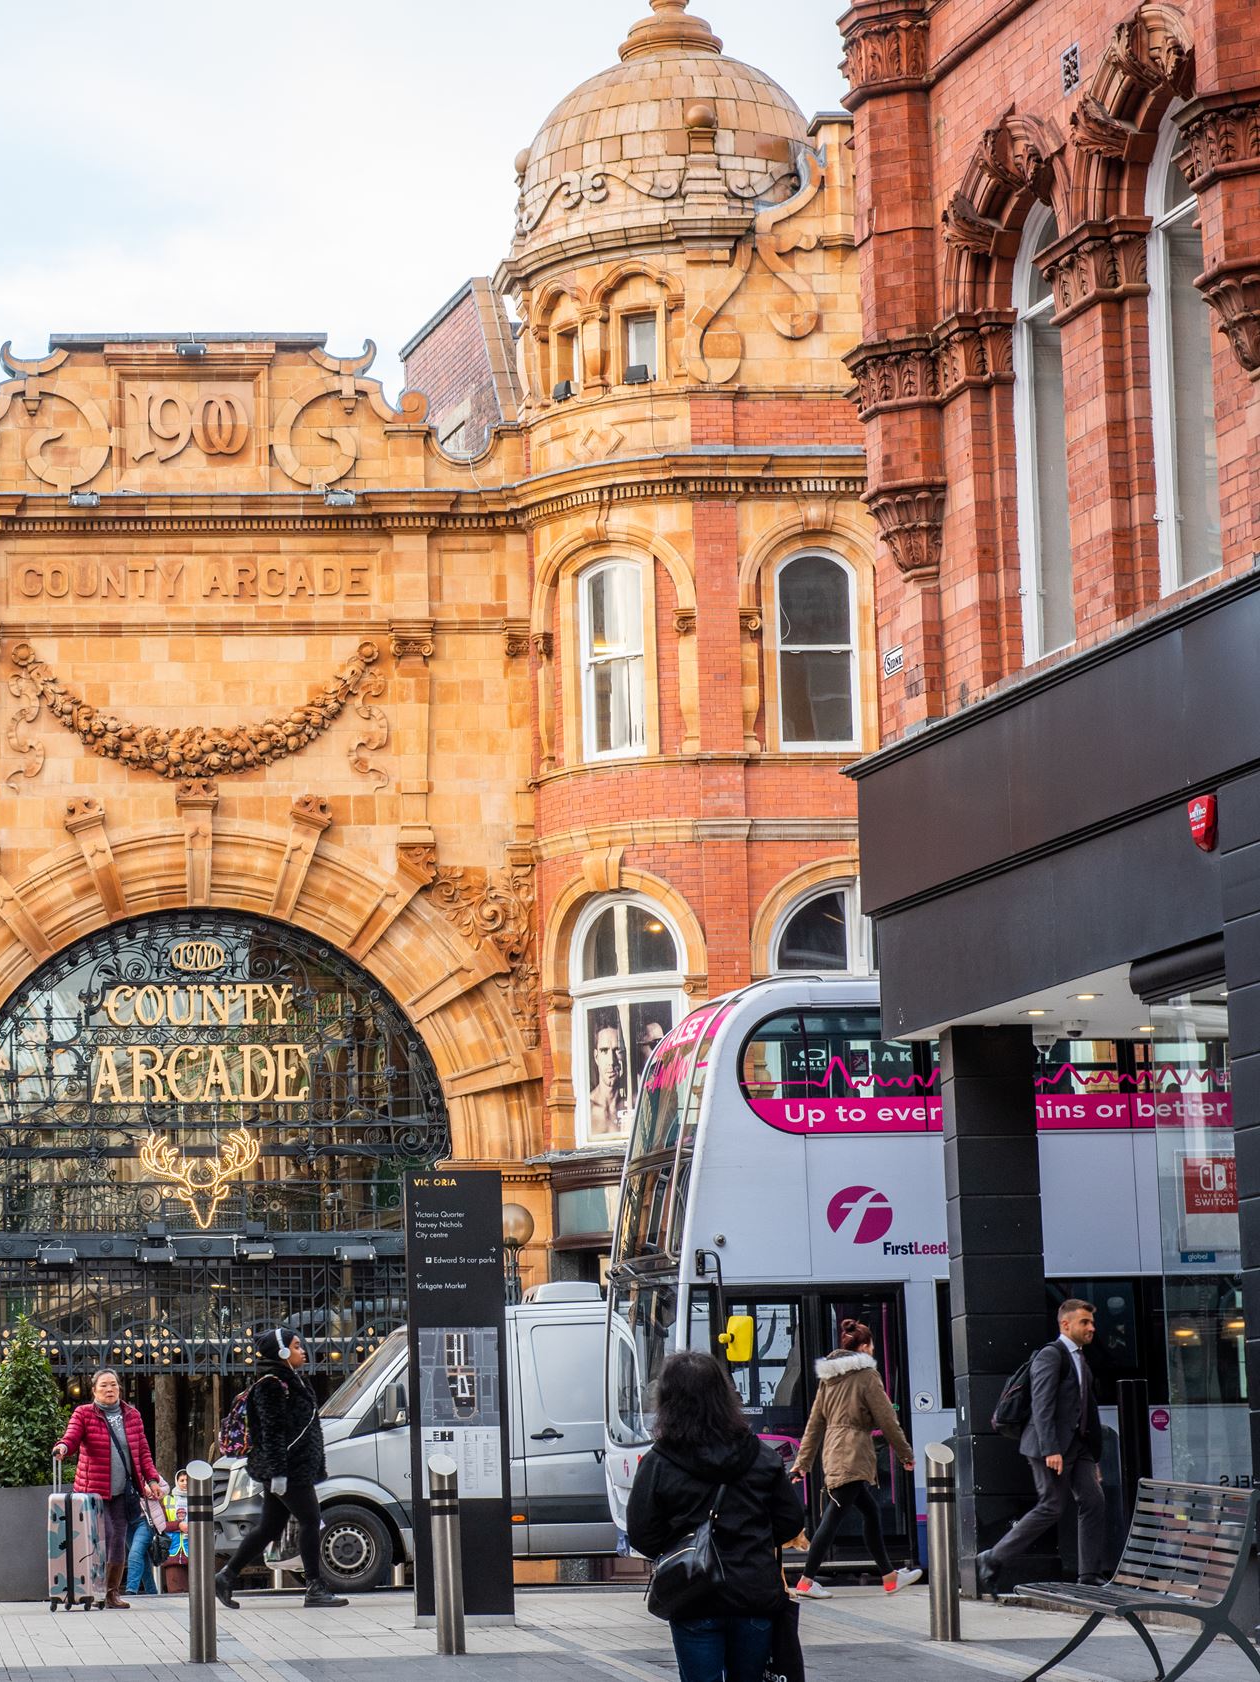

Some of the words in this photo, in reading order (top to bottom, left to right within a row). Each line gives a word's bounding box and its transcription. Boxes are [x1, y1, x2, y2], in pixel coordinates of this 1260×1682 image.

[131, 391, 249, 463] 1900
[17, 561, 185, 599] COUNTY
[201, 561, 370, 598] ARCADE
[177, 942, 222, 968] 1900
[103, 984, 293, 1026] COUNTY
[91, 1044, 310, 1103] ARCADE
[784, 1104, 826, 1128] Up
[835, 1106, 867, 1122] to
[877, 1105, 943, 1122] ever
[1096, 1105, 1126, 1118] or
[1136, 1098, 1228, 1118] better
[1194, 1198, 1234, 1206] SWITCH
[440, 1210, 465, 1219] Quarter
[415, 1221, 438, 1229] Harvey
[415, 1231, 428, 1239] City
[883, 1242, 949, 1255] FirstLeed
[433, 1256, 457, 1264] Edward
[478, 1256, 496, 1265] parks
[1187, 1253, 1209, 1262] global
[417, 1282, 443, 1291] Kirkgate
